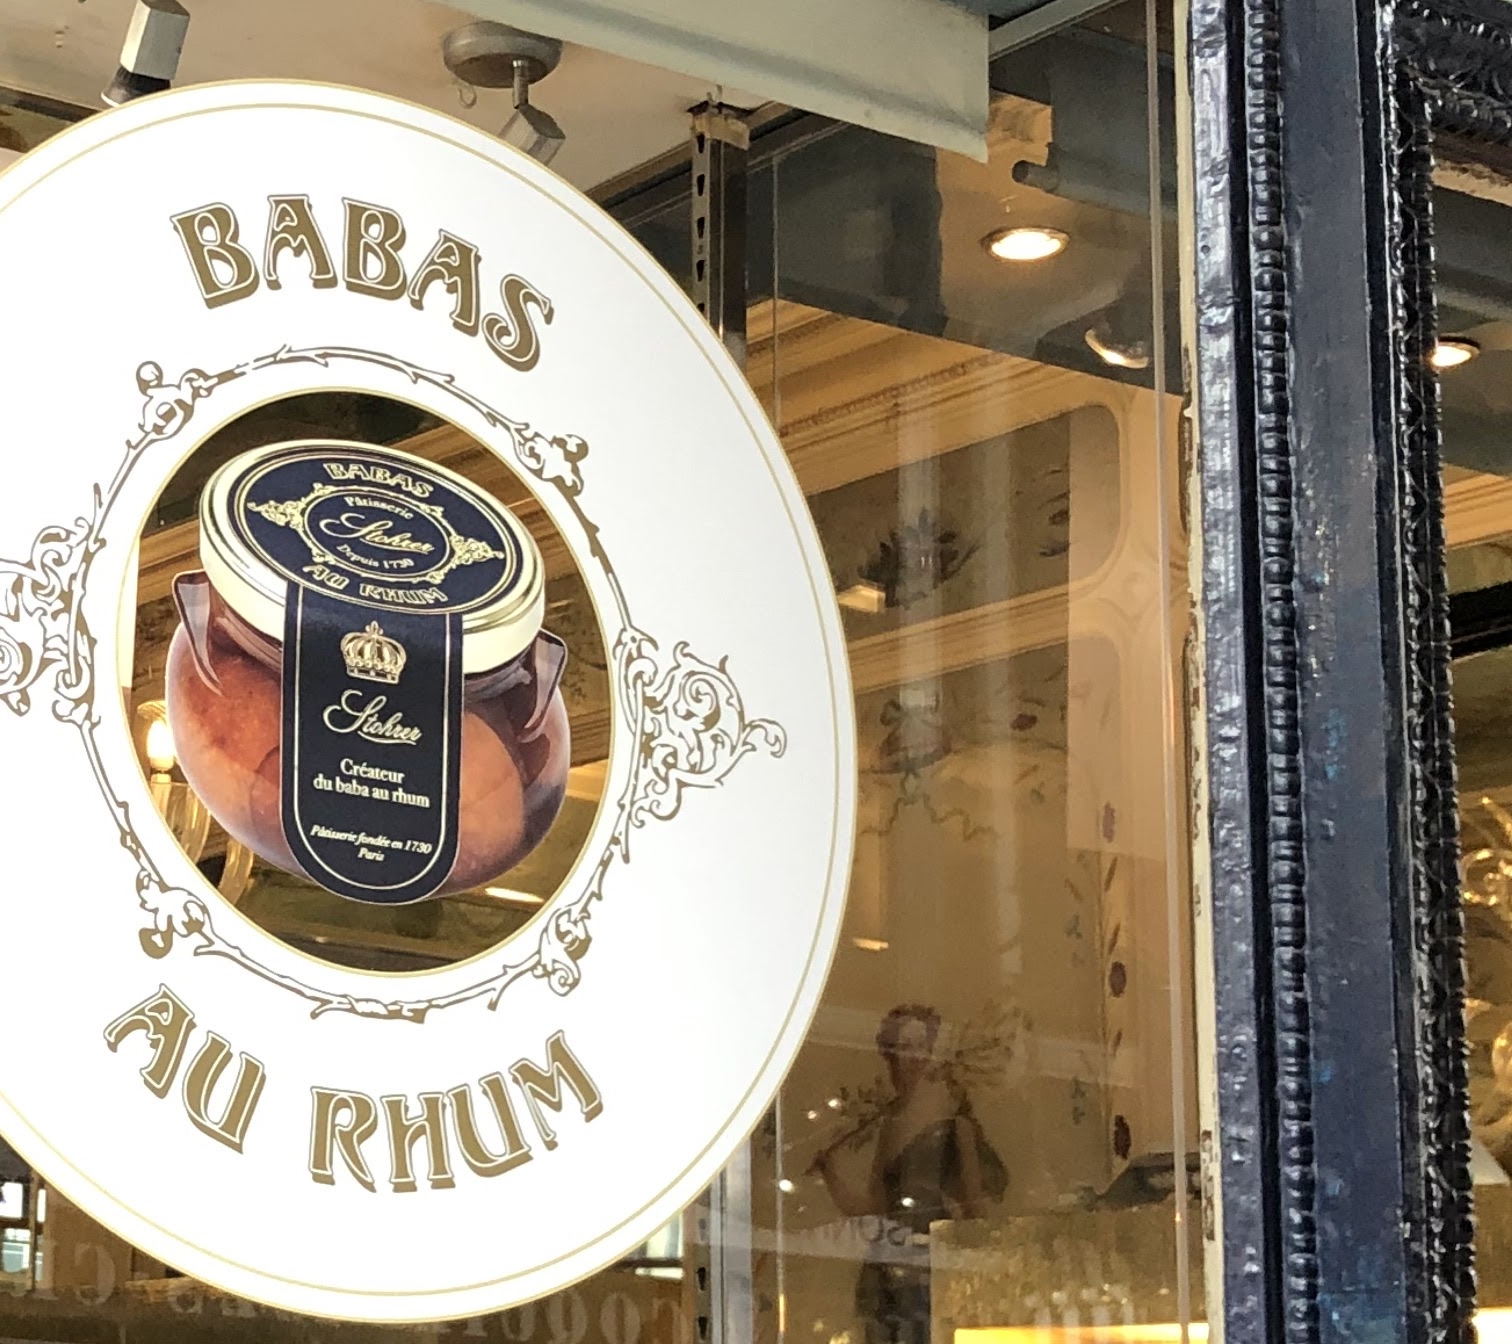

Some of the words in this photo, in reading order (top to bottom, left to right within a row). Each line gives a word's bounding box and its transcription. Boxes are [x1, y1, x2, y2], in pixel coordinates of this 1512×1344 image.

[170, 194, 555, 372] BABAS
[323, 462, 434, 498] BABAS
[343, 496, 414, 520] Pâtisserie
[319, 513, 435, 554] Stohrer
[337, 544, 380, 568] Depuis
[302, 564, 350, 590] AU
[359, 583, 448, 605] RHUM
[323, 689, 423, 745] Stohrer
[340, 758, 405, 784] Créateur
[313, 773, 333, 791] du
[335, 776, 370, 798] baba
[372, 787, 389, 801] au
[392, 787, 430, 808] rhum
[354, 832, 390, 848] fondée
[391, 840, 403, 849] en
[404, 839, 433, 855] 1730
[357, 846, 385, 862] Paris
[103, 983, 267, 1155] AU
[308, 1029, 605, 1194] RHUM
